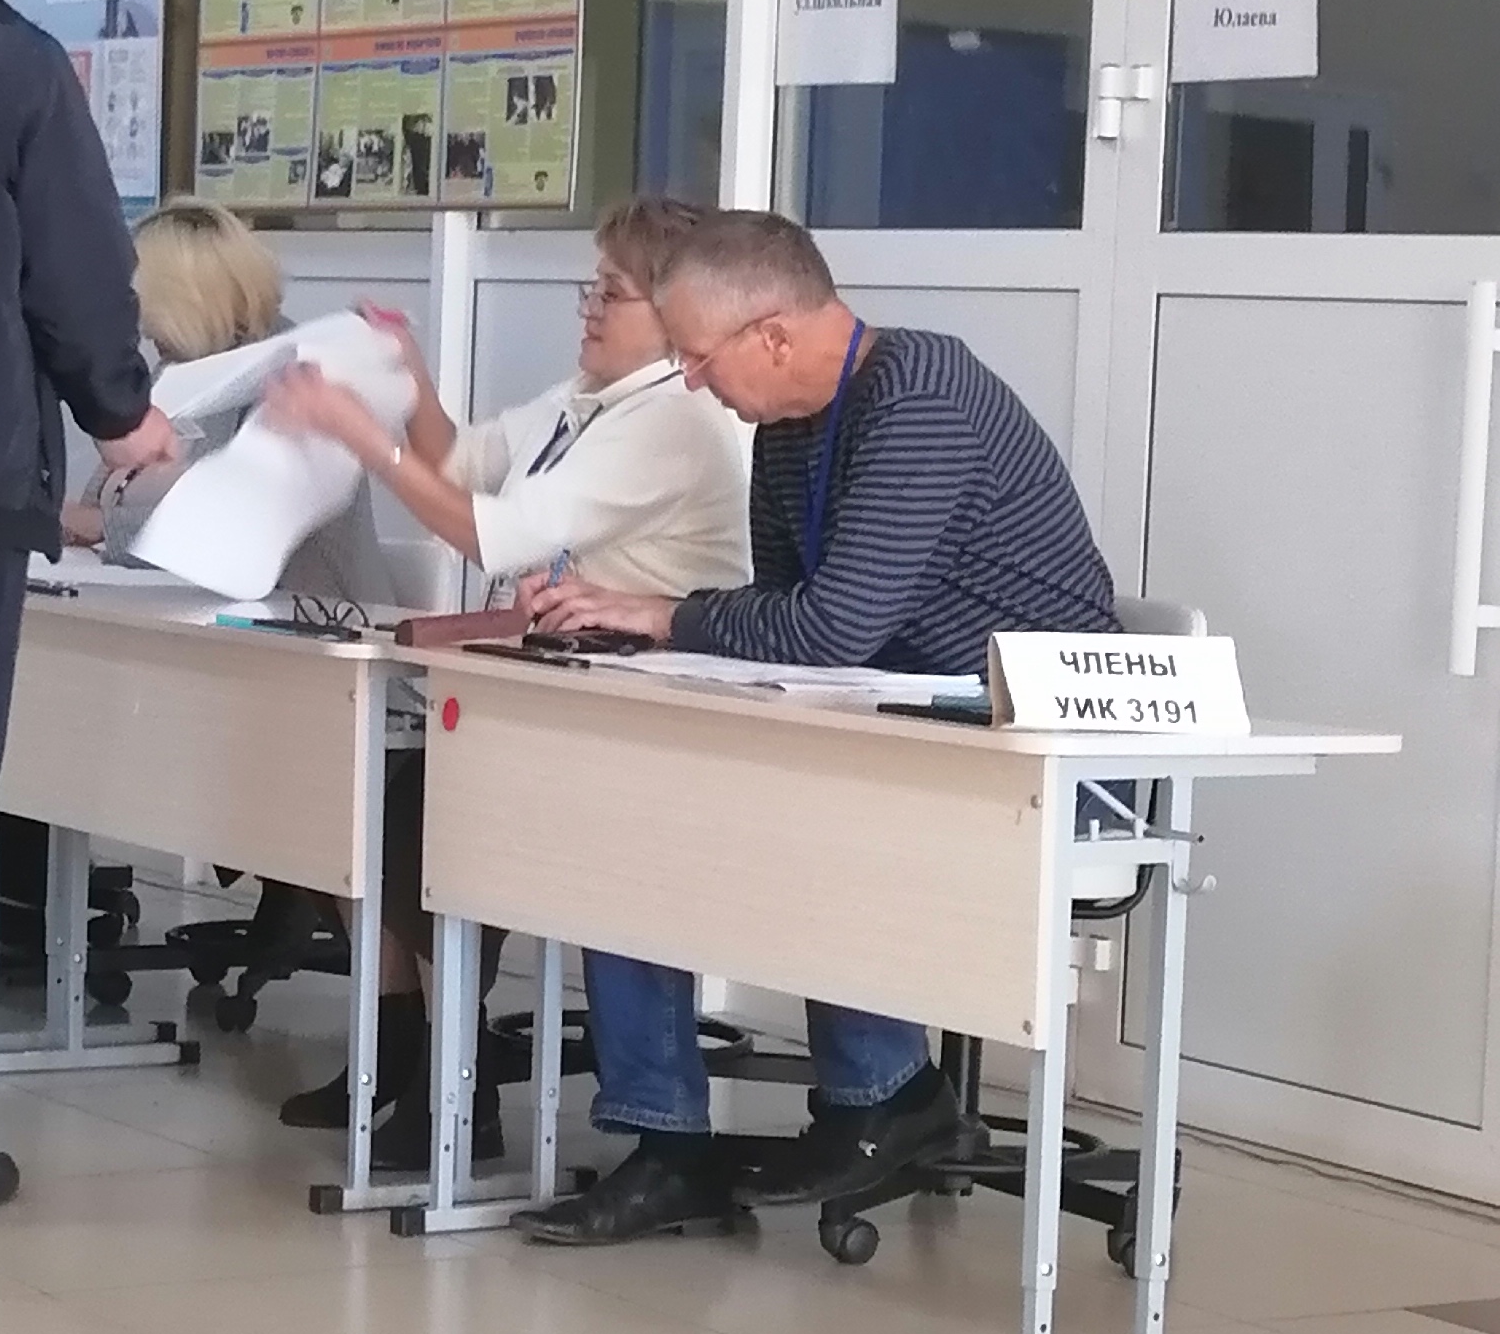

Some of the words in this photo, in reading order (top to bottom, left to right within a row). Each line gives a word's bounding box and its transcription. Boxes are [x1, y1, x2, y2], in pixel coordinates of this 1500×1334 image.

[1213, 7, 1277, 27] Юлаева
[1058, 650, 1178, 678] ЧЛЕНЫ
[1054, 695, 1118, 721] УИК
[1127, 698, 1198, 725] 3191
